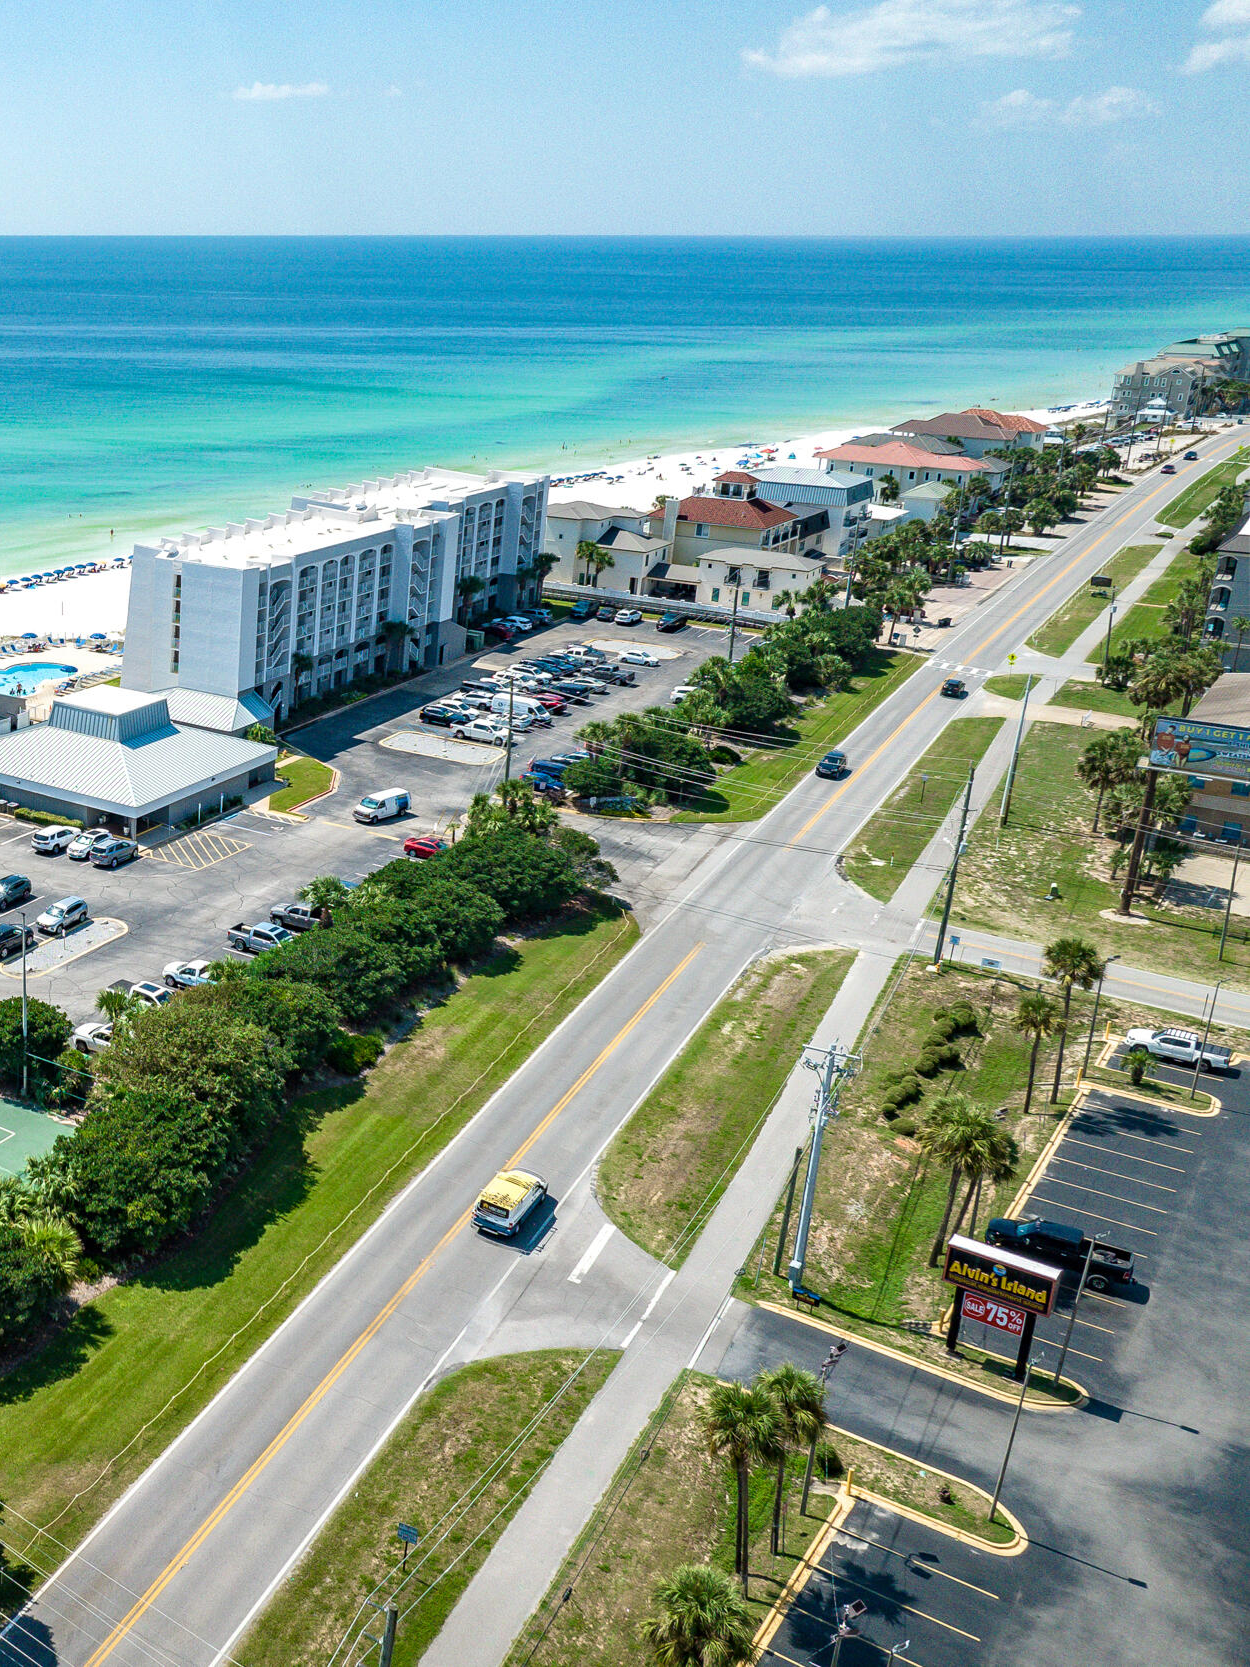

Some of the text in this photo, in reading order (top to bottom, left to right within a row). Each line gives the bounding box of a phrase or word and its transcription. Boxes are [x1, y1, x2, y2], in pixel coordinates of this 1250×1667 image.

[1179, 725, 1203, 734] BUY
[1213, 730, 1236, 738] GET
[949, 1260, 1047, 1304] Alvin's Island
[966, 1301, 1022, 1326] SALE 75%
[1007, 1322, 1021, 1332] OFF
